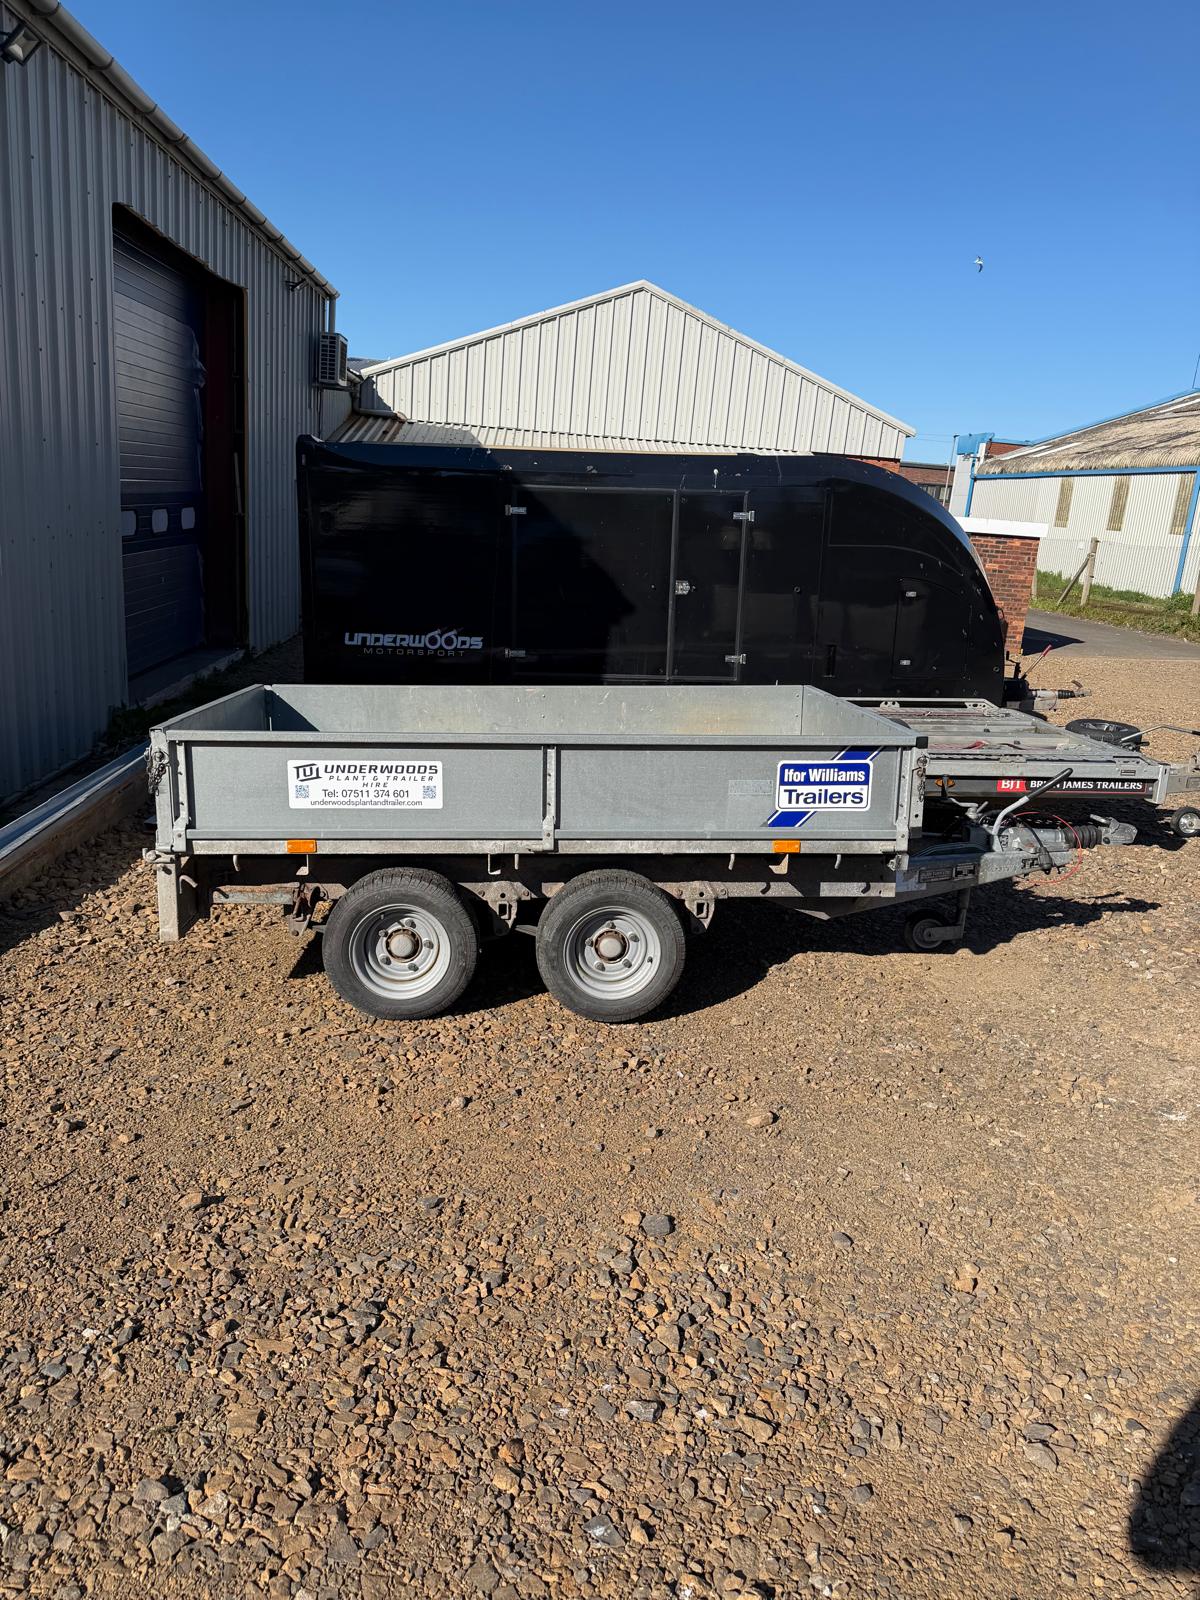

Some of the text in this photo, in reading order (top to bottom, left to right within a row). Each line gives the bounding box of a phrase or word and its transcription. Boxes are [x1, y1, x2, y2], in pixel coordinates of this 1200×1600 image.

[344, 629, 484, 650] UNDERWOODS
[363, 647, 465, 657] MOTORSPORT
[324, 764, 438, 775] UNDERWOODS
[784, 768, 866, 782] Ifor Williams
[1062, 781, 1094, 790] JAMES
[1097, 781, 1143, 790] TRAILERS
[322, 789, 410, 798] Tel: 07511 374 601
[783, 788, 864, 805] Trailers
[310, 799, 423, 807] underwoodsplantandtrailer.com
